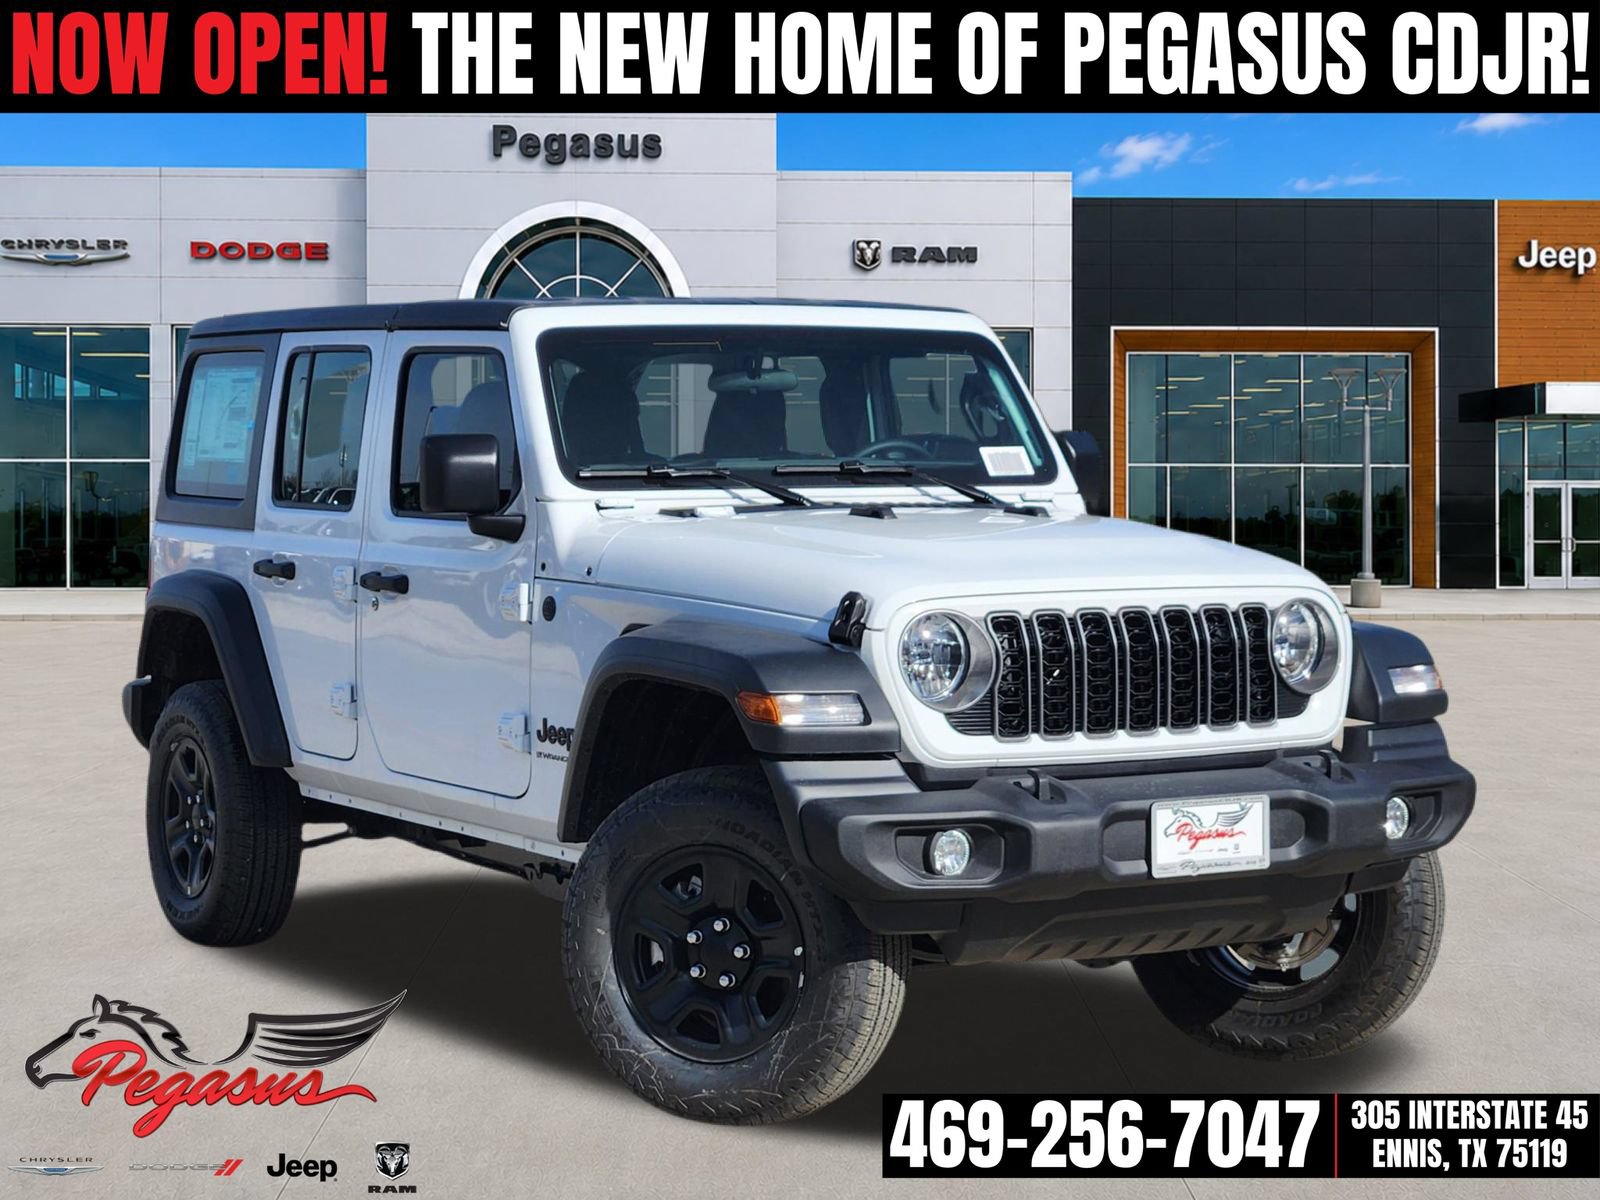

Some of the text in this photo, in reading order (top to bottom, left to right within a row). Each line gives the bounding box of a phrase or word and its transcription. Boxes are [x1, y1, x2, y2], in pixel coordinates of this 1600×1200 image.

[492, 124, 662, 166] Pegasus
[0, 239, 128, 250] CHRYSLER
[190, 241, 329, 260] DODGE
[891, 246, 978, 263] RAM
[1518, 239, 1597, 275] Jeep
